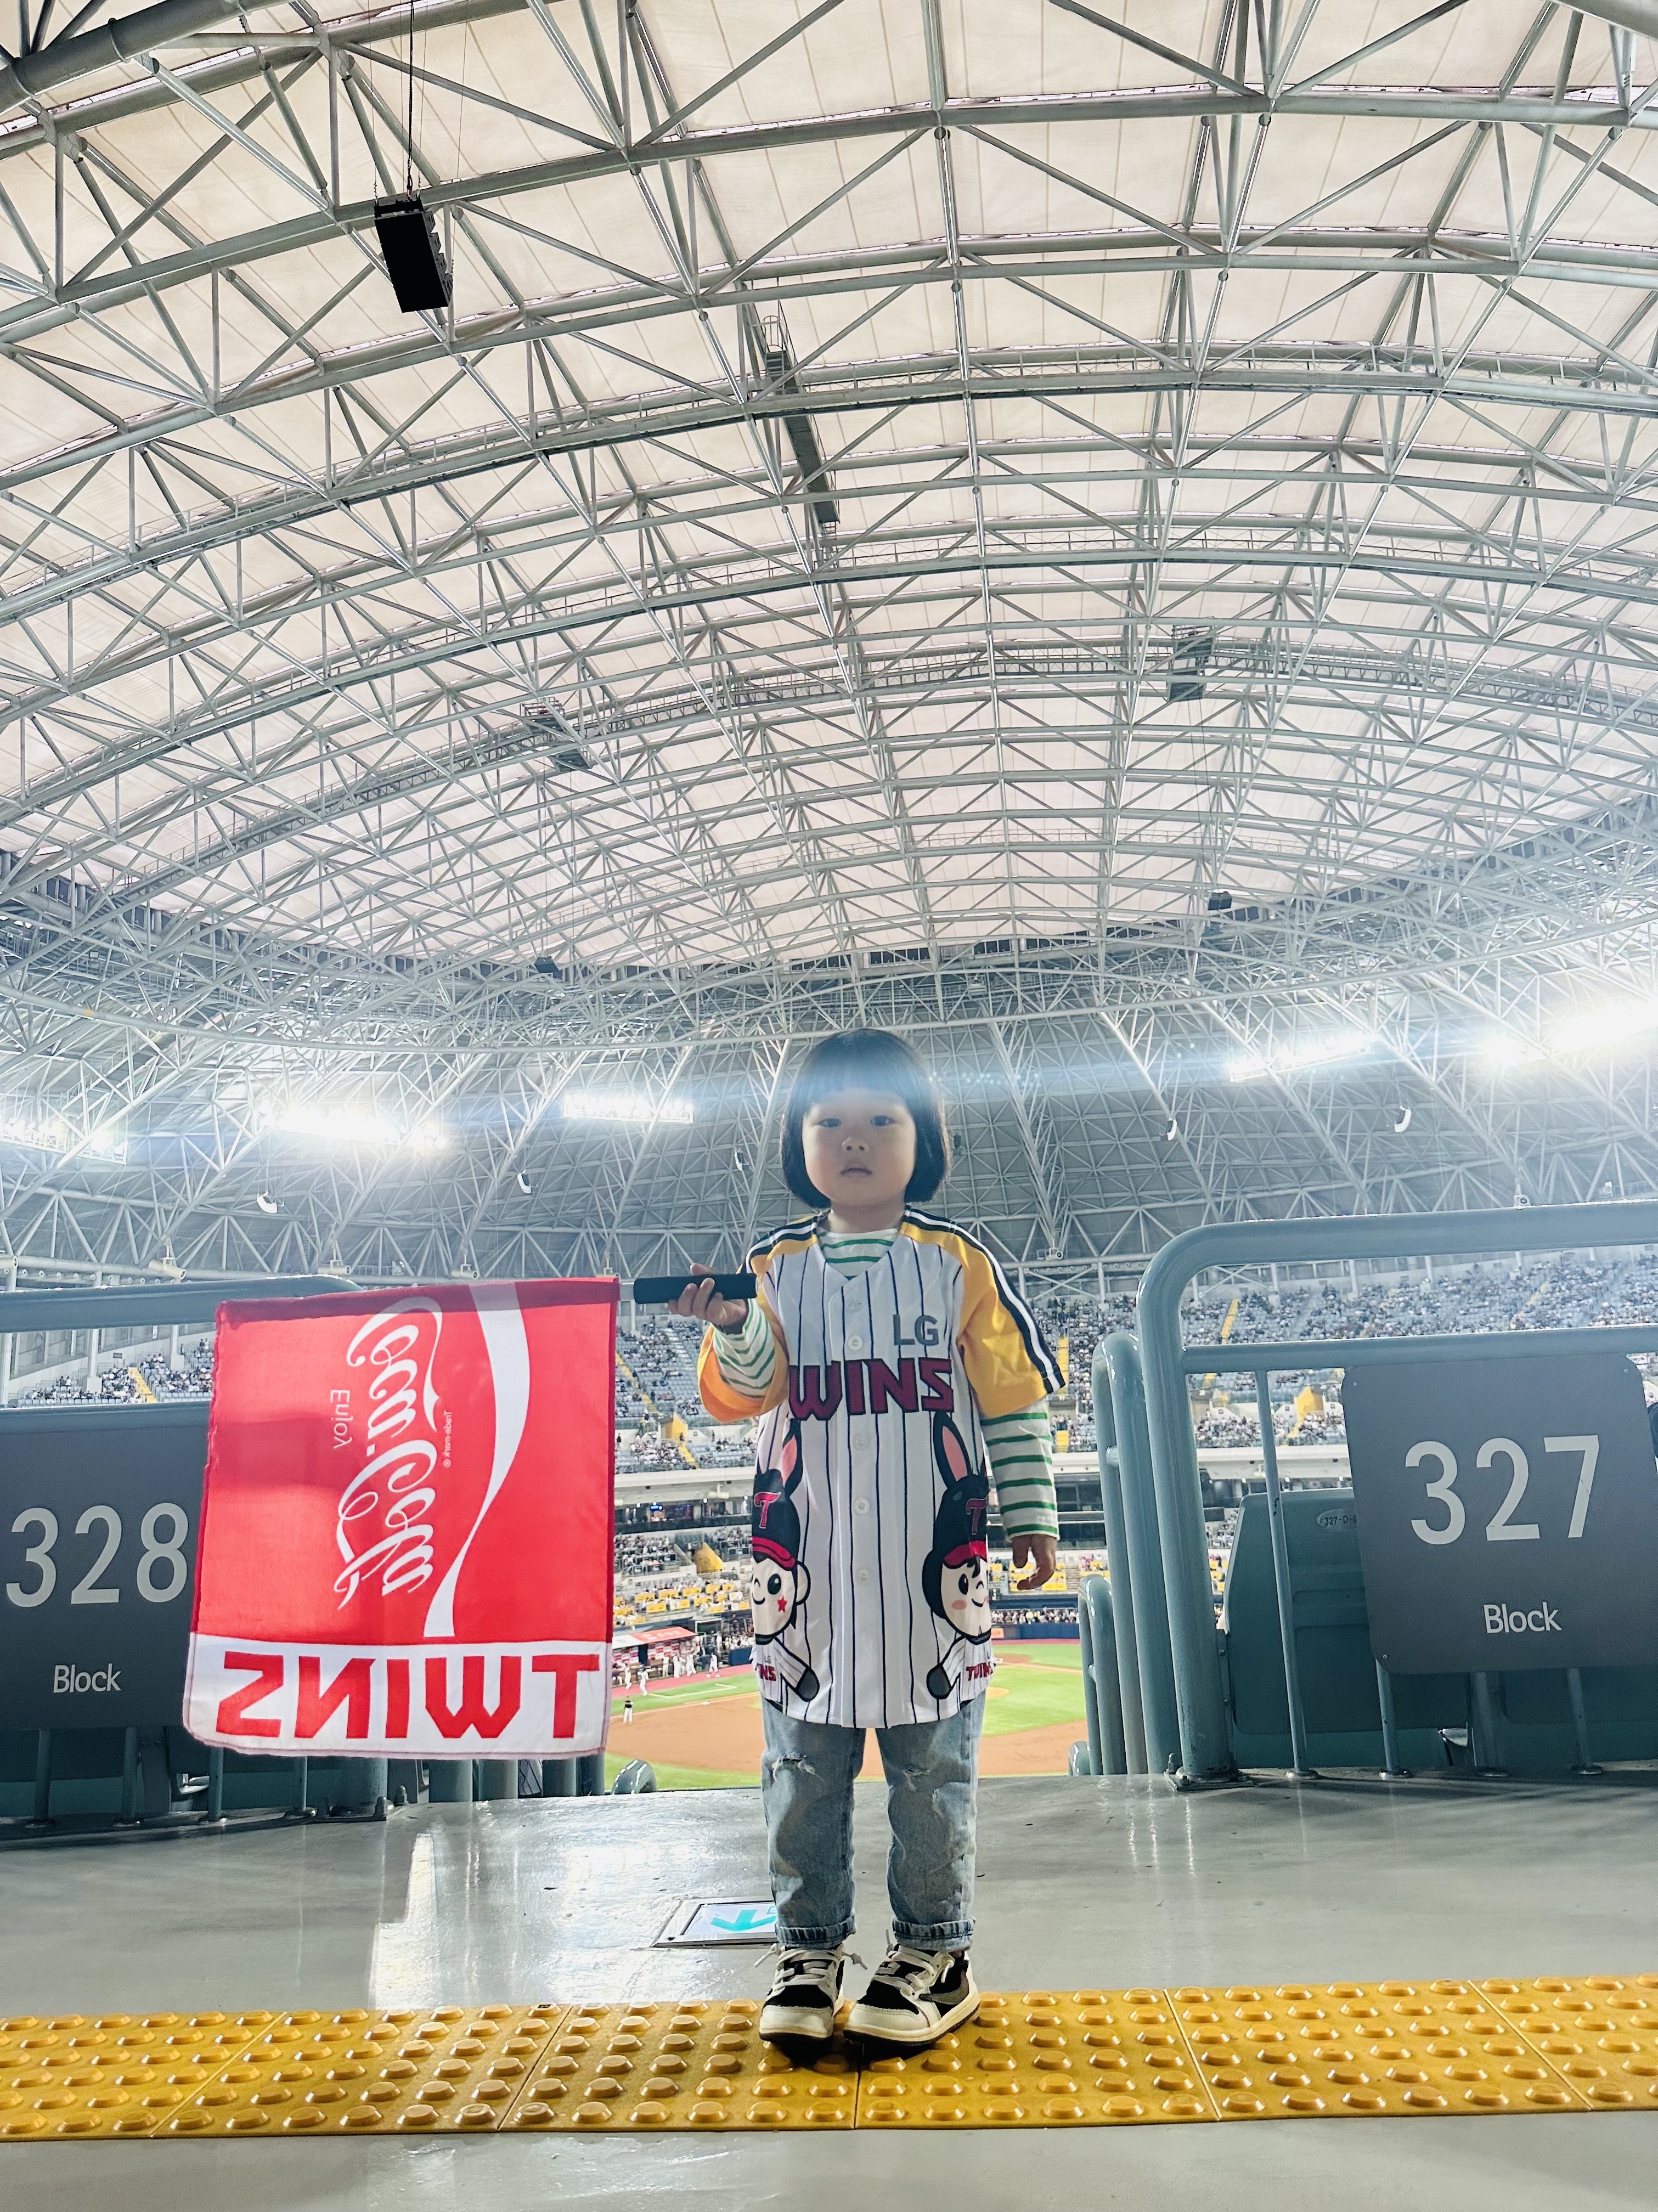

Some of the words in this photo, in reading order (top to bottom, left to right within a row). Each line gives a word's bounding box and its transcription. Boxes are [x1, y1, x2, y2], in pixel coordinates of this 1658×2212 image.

[893, 1314, 939, 1346] LG
[788, 1357, 954, 1420] WINS
[1405, 1435, 1600, 1545] 327
[754, 1492, 782, 1529] T
[6, 1503, 188, 1607] 328
[1484, 1602, 1562, 1633] Block
[53, 1664, 121, 1693] Block
